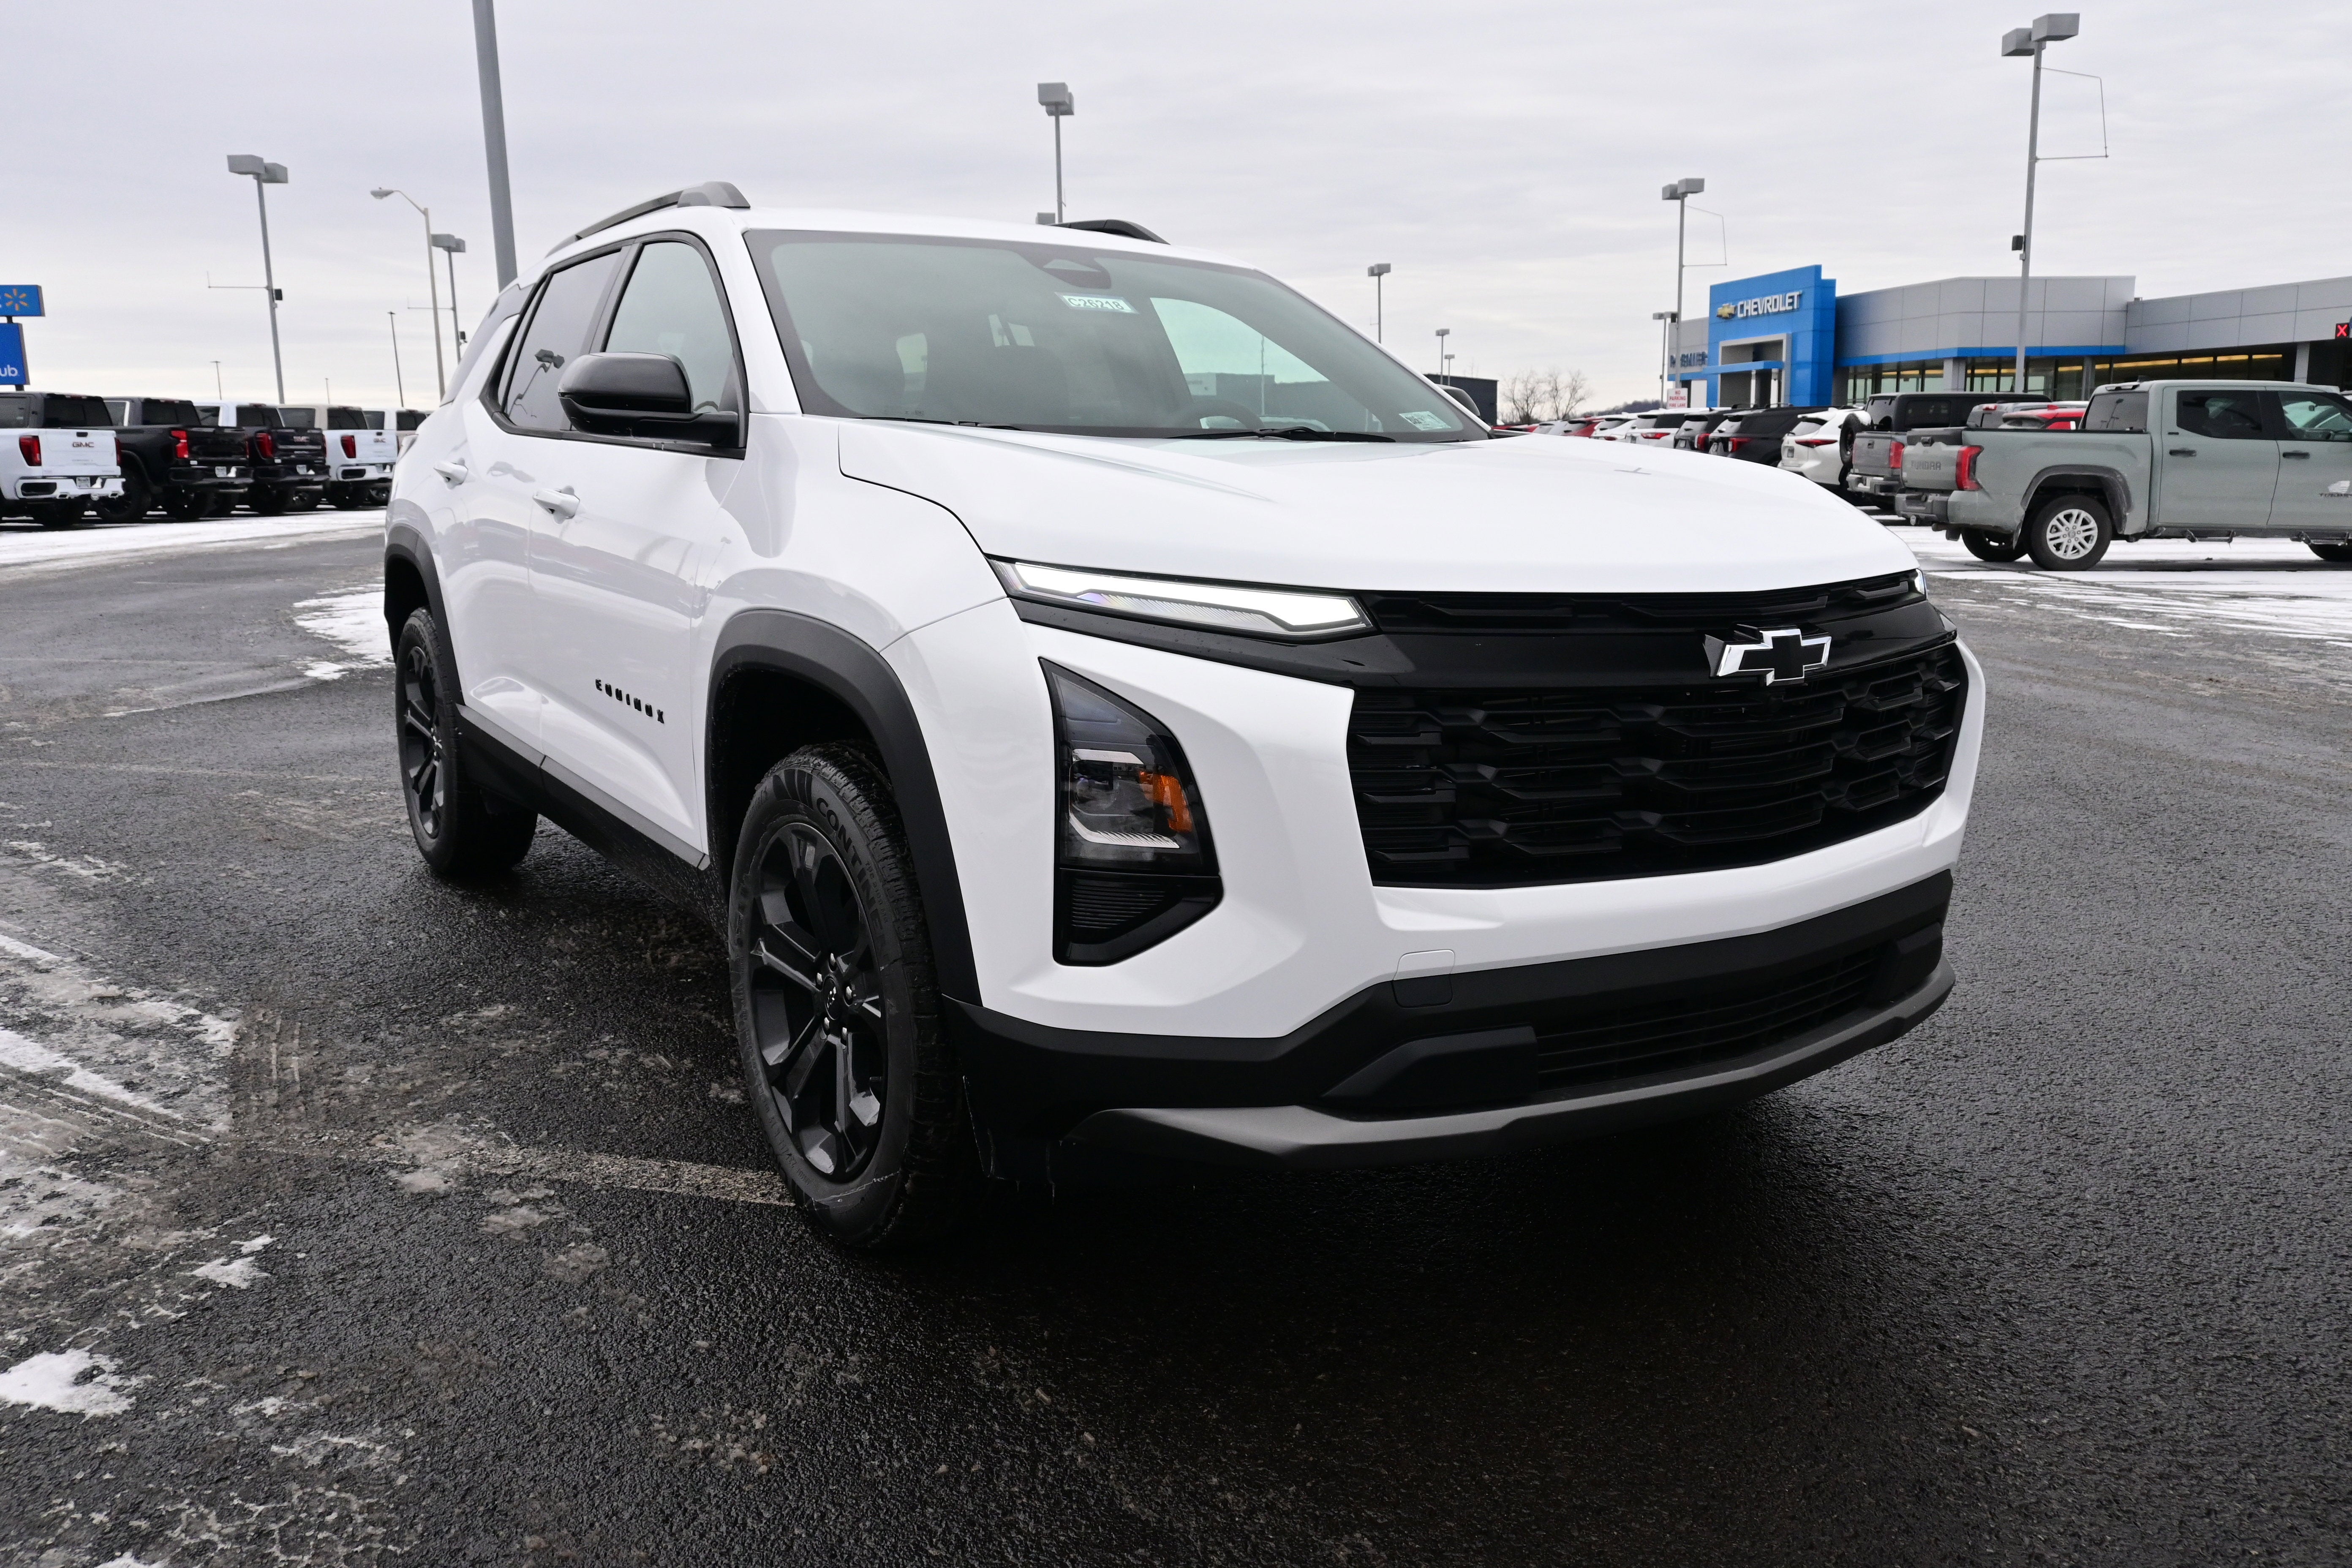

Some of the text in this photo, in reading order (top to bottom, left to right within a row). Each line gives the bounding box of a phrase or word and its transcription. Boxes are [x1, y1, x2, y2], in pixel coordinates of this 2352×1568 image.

[1068, 298, 1124, 310] C26218
[1737, 291, 1800, 318] CHEVROLET
[1911, 460, 1941, 471] TUNDRA
[595, 678, 664, 724] EQUINOX
